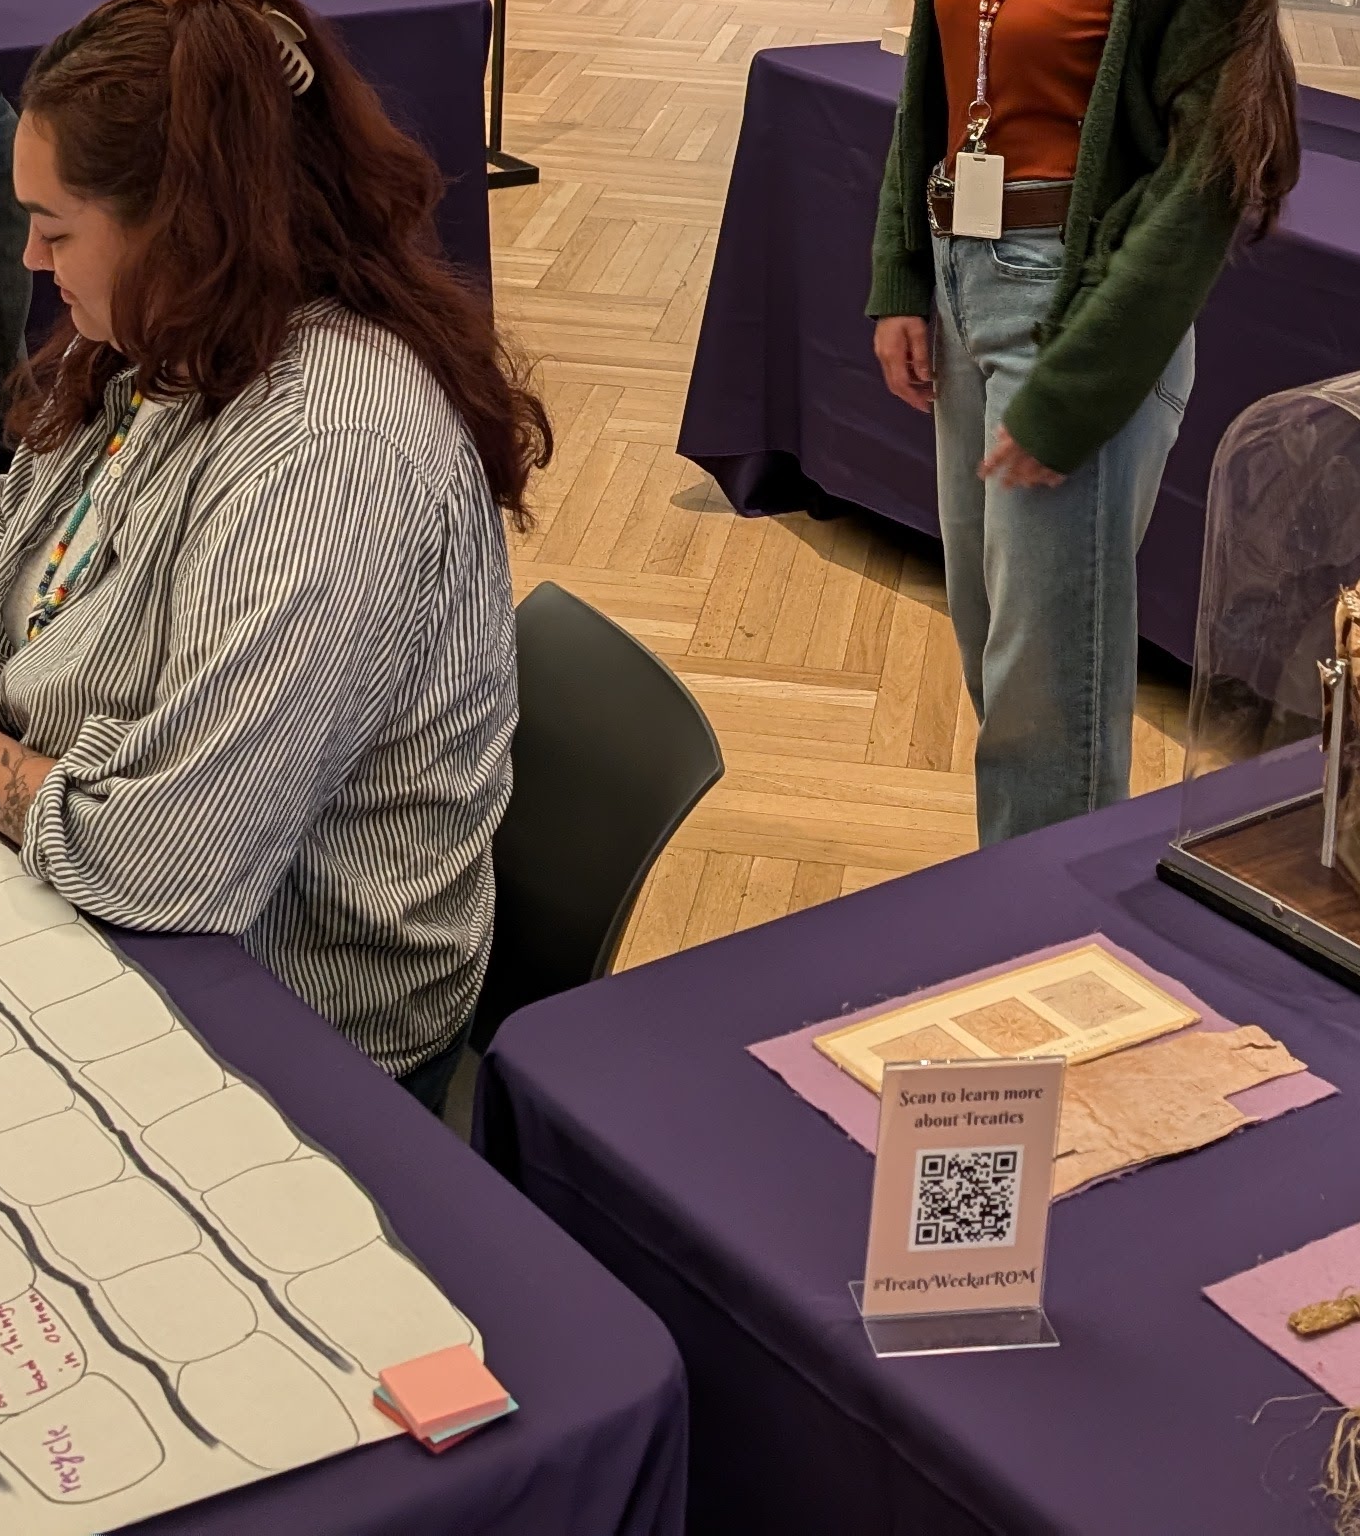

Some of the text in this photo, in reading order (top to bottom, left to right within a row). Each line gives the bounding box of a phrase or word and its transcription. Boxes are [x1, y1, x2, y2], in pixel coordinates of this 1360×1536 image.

[899, 1087, 1043, 1107] Scan to learn more
[914, 1112, 1025, 1128] about Treaties
[873, 1267, 1036, 1294] #TreatyWeekatROM
